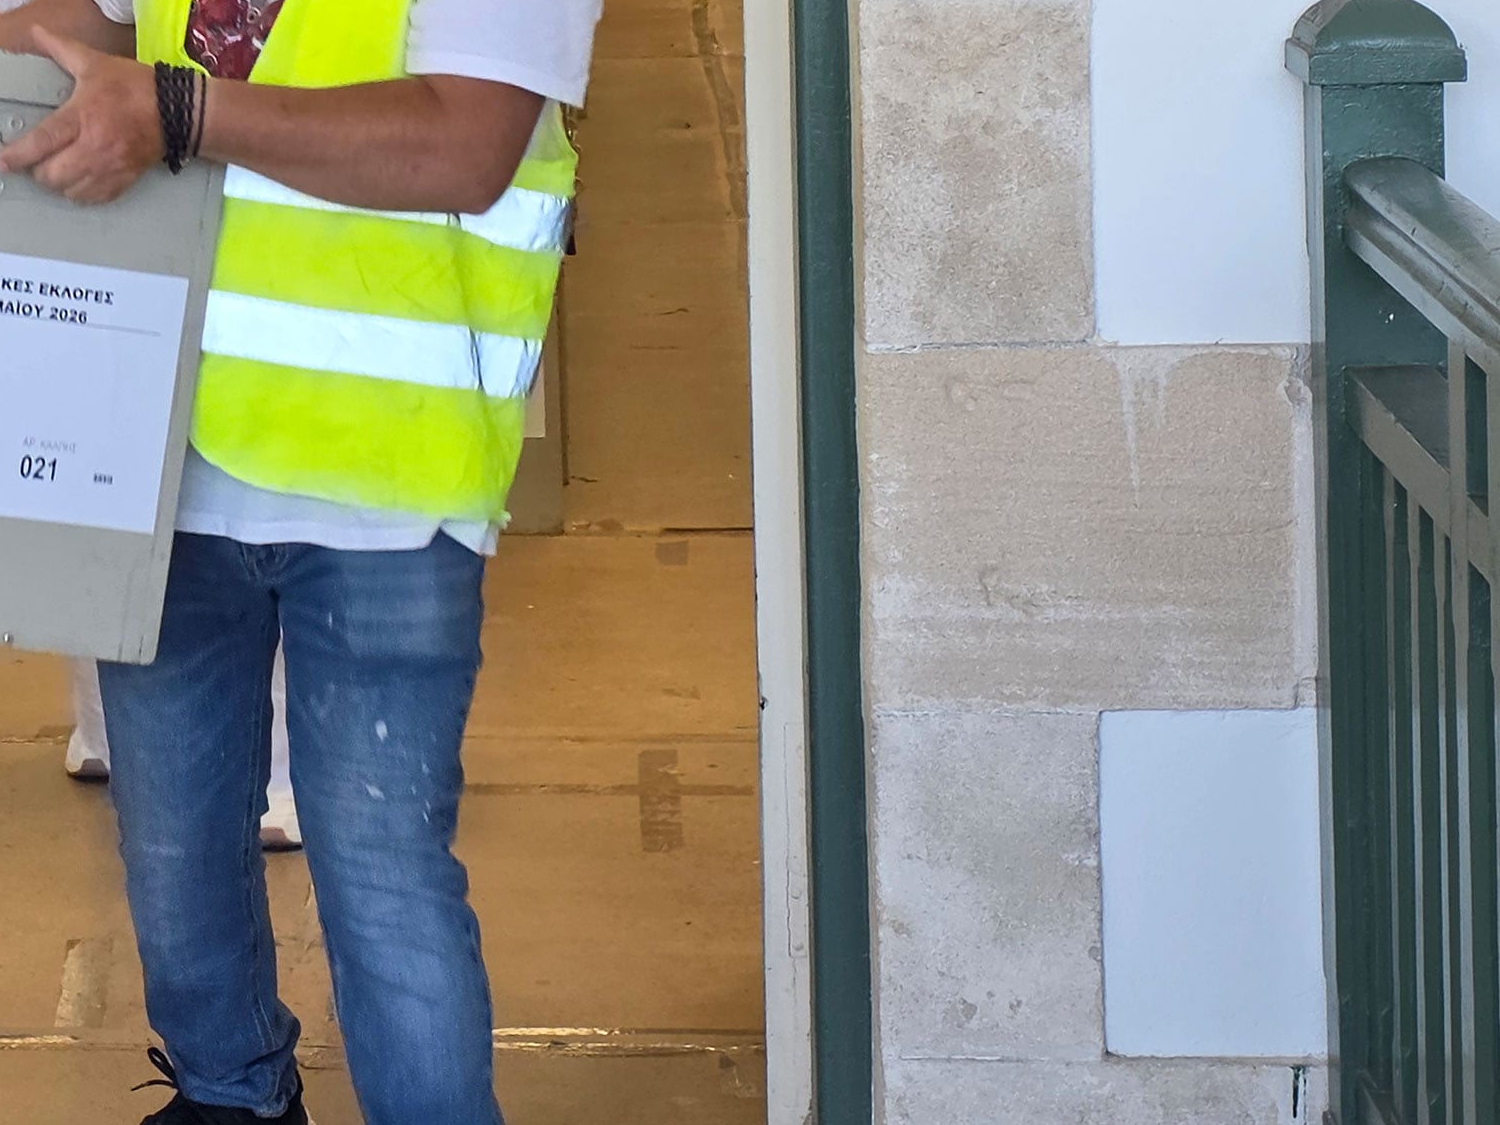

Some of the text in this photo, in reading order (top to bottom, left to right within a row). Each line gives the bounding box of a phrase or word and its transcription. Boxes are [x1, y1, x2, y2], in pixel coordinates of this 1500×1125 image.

[39, 282, 115, 306] ΕΚΛΟΓΕΣ
[49, 307, 88, 324] 2026
[20, 454, 58, 482] 021
